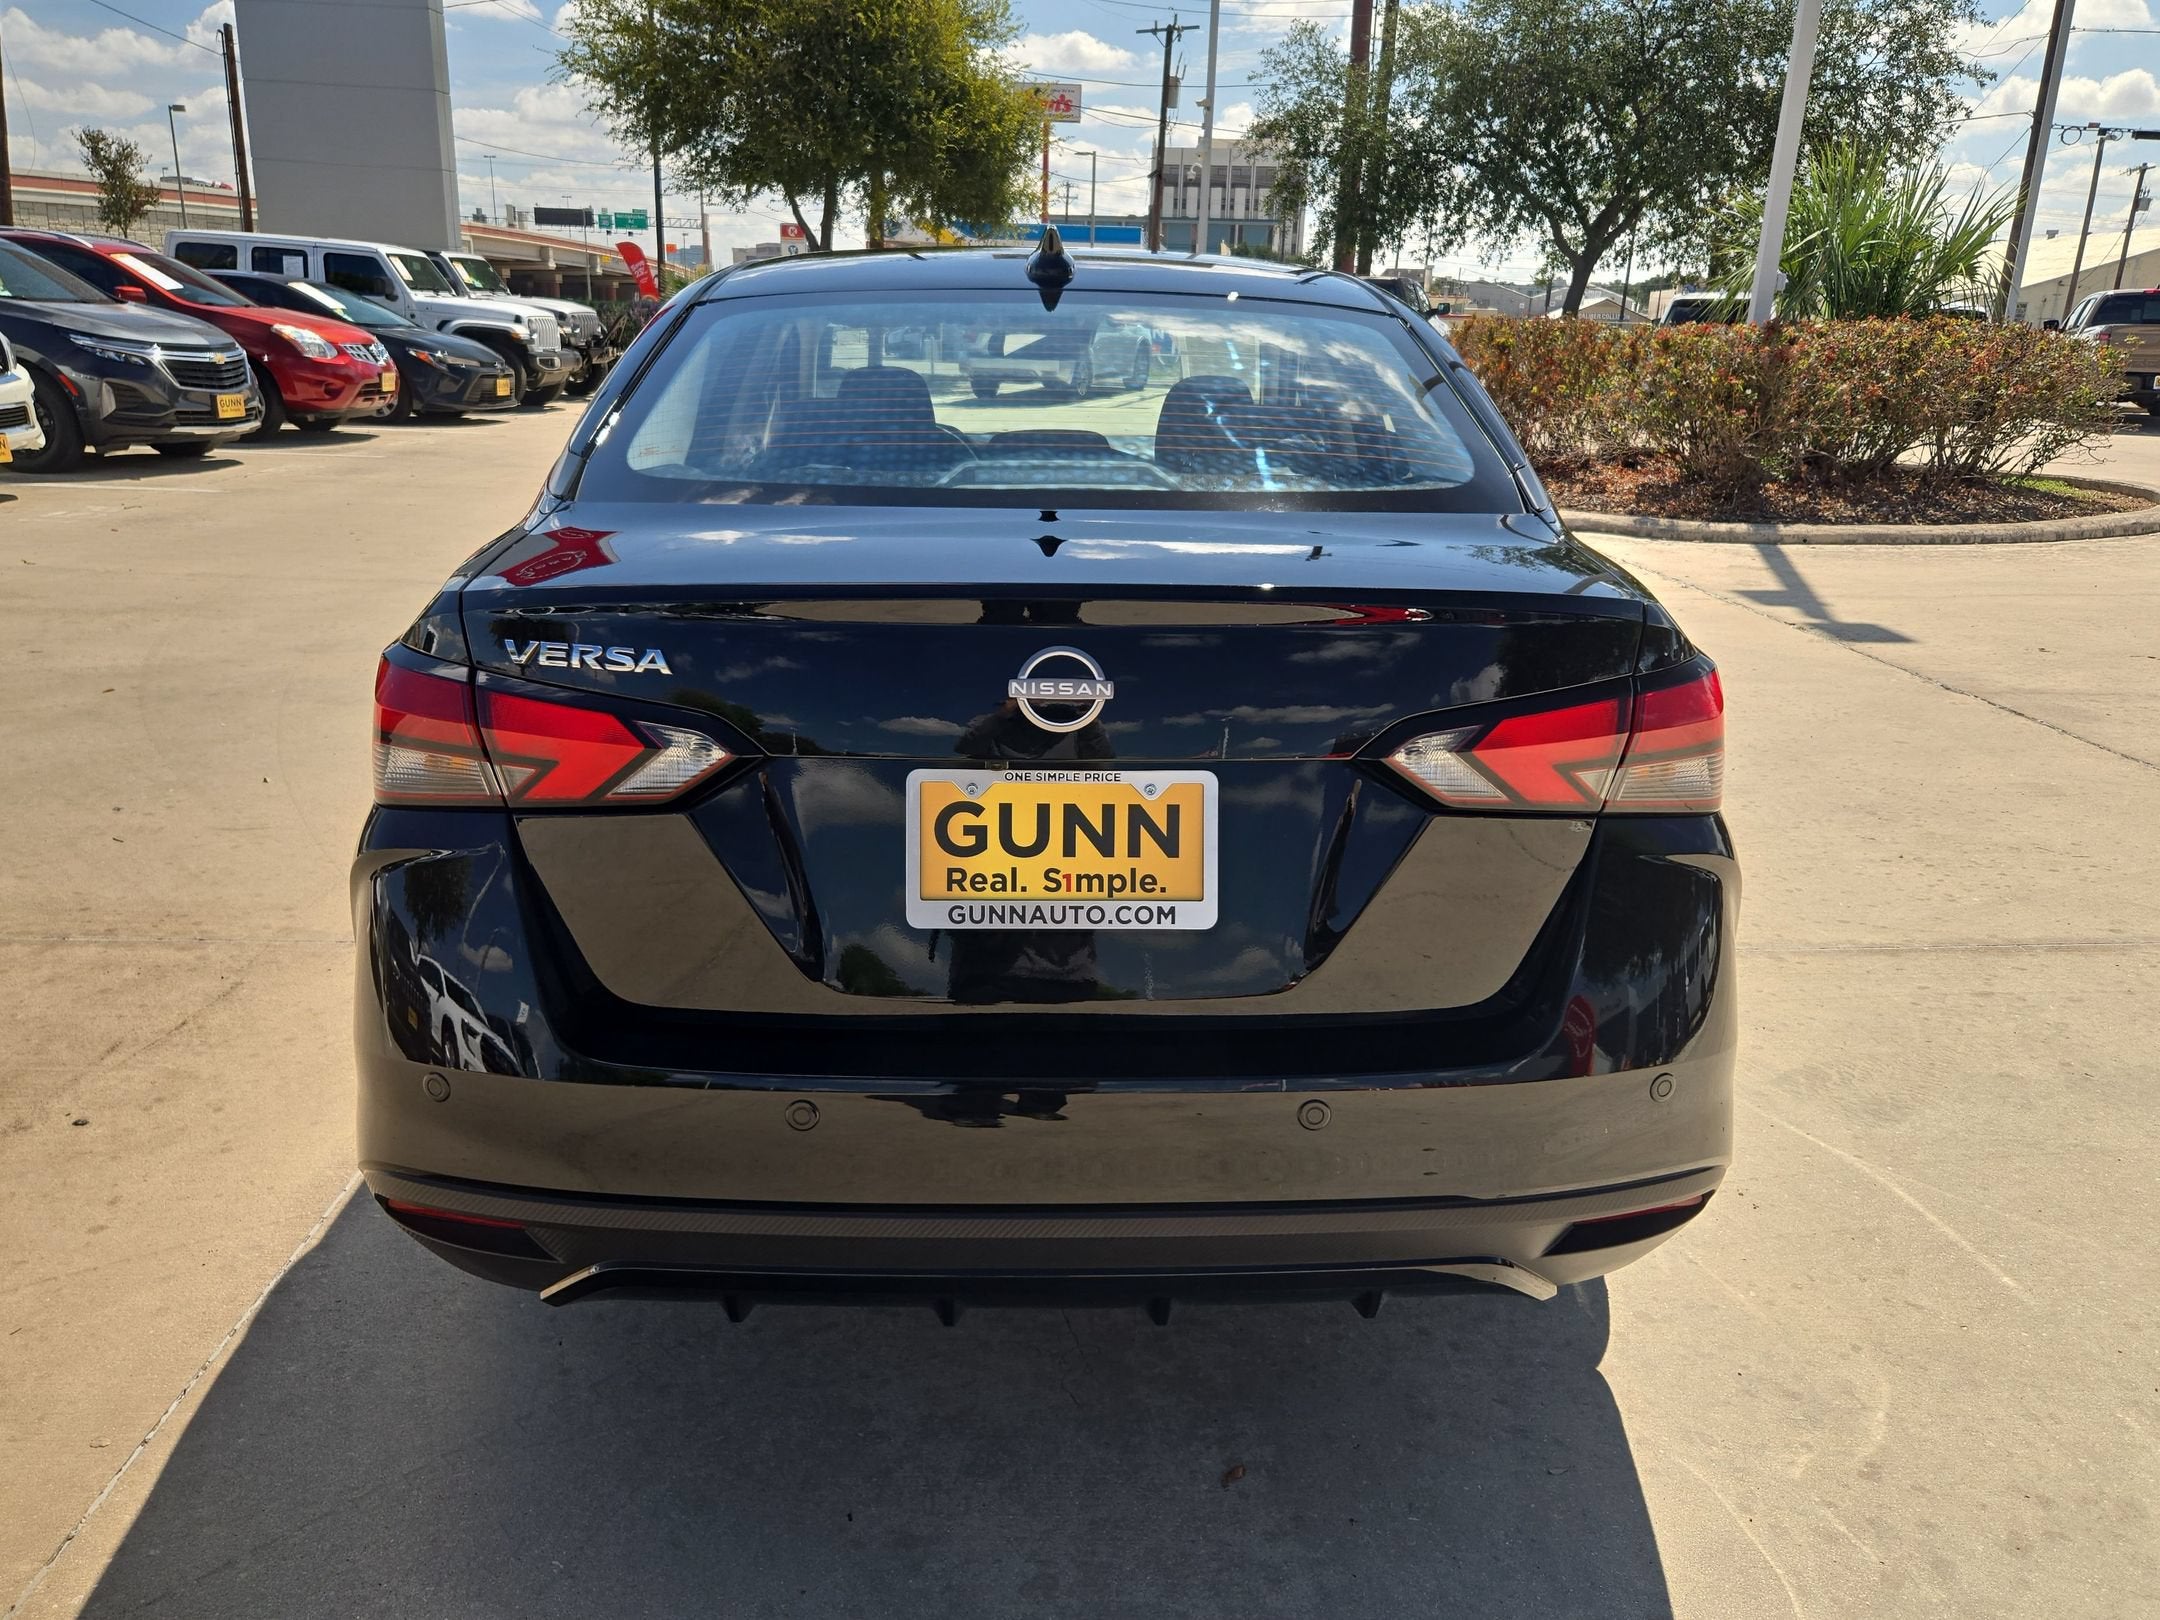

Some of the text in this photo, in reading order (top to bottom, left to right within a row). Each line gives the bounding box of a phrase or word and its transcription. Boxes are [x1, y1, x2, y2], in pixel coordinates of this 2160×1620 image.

[219, 397, 242, 408] GUNN
[504, 639, 673, 675] VERSA
[1010, 681, 1112, 696] NISSAN
[1004, 771, 1121, 782] ONE SIMPLE PRICE
[933, 800, 1181, 859] GUNN
[946, 866, 1028, 893] Real.
[947, 904, 1176, 925] GUNNAUTO.COM
